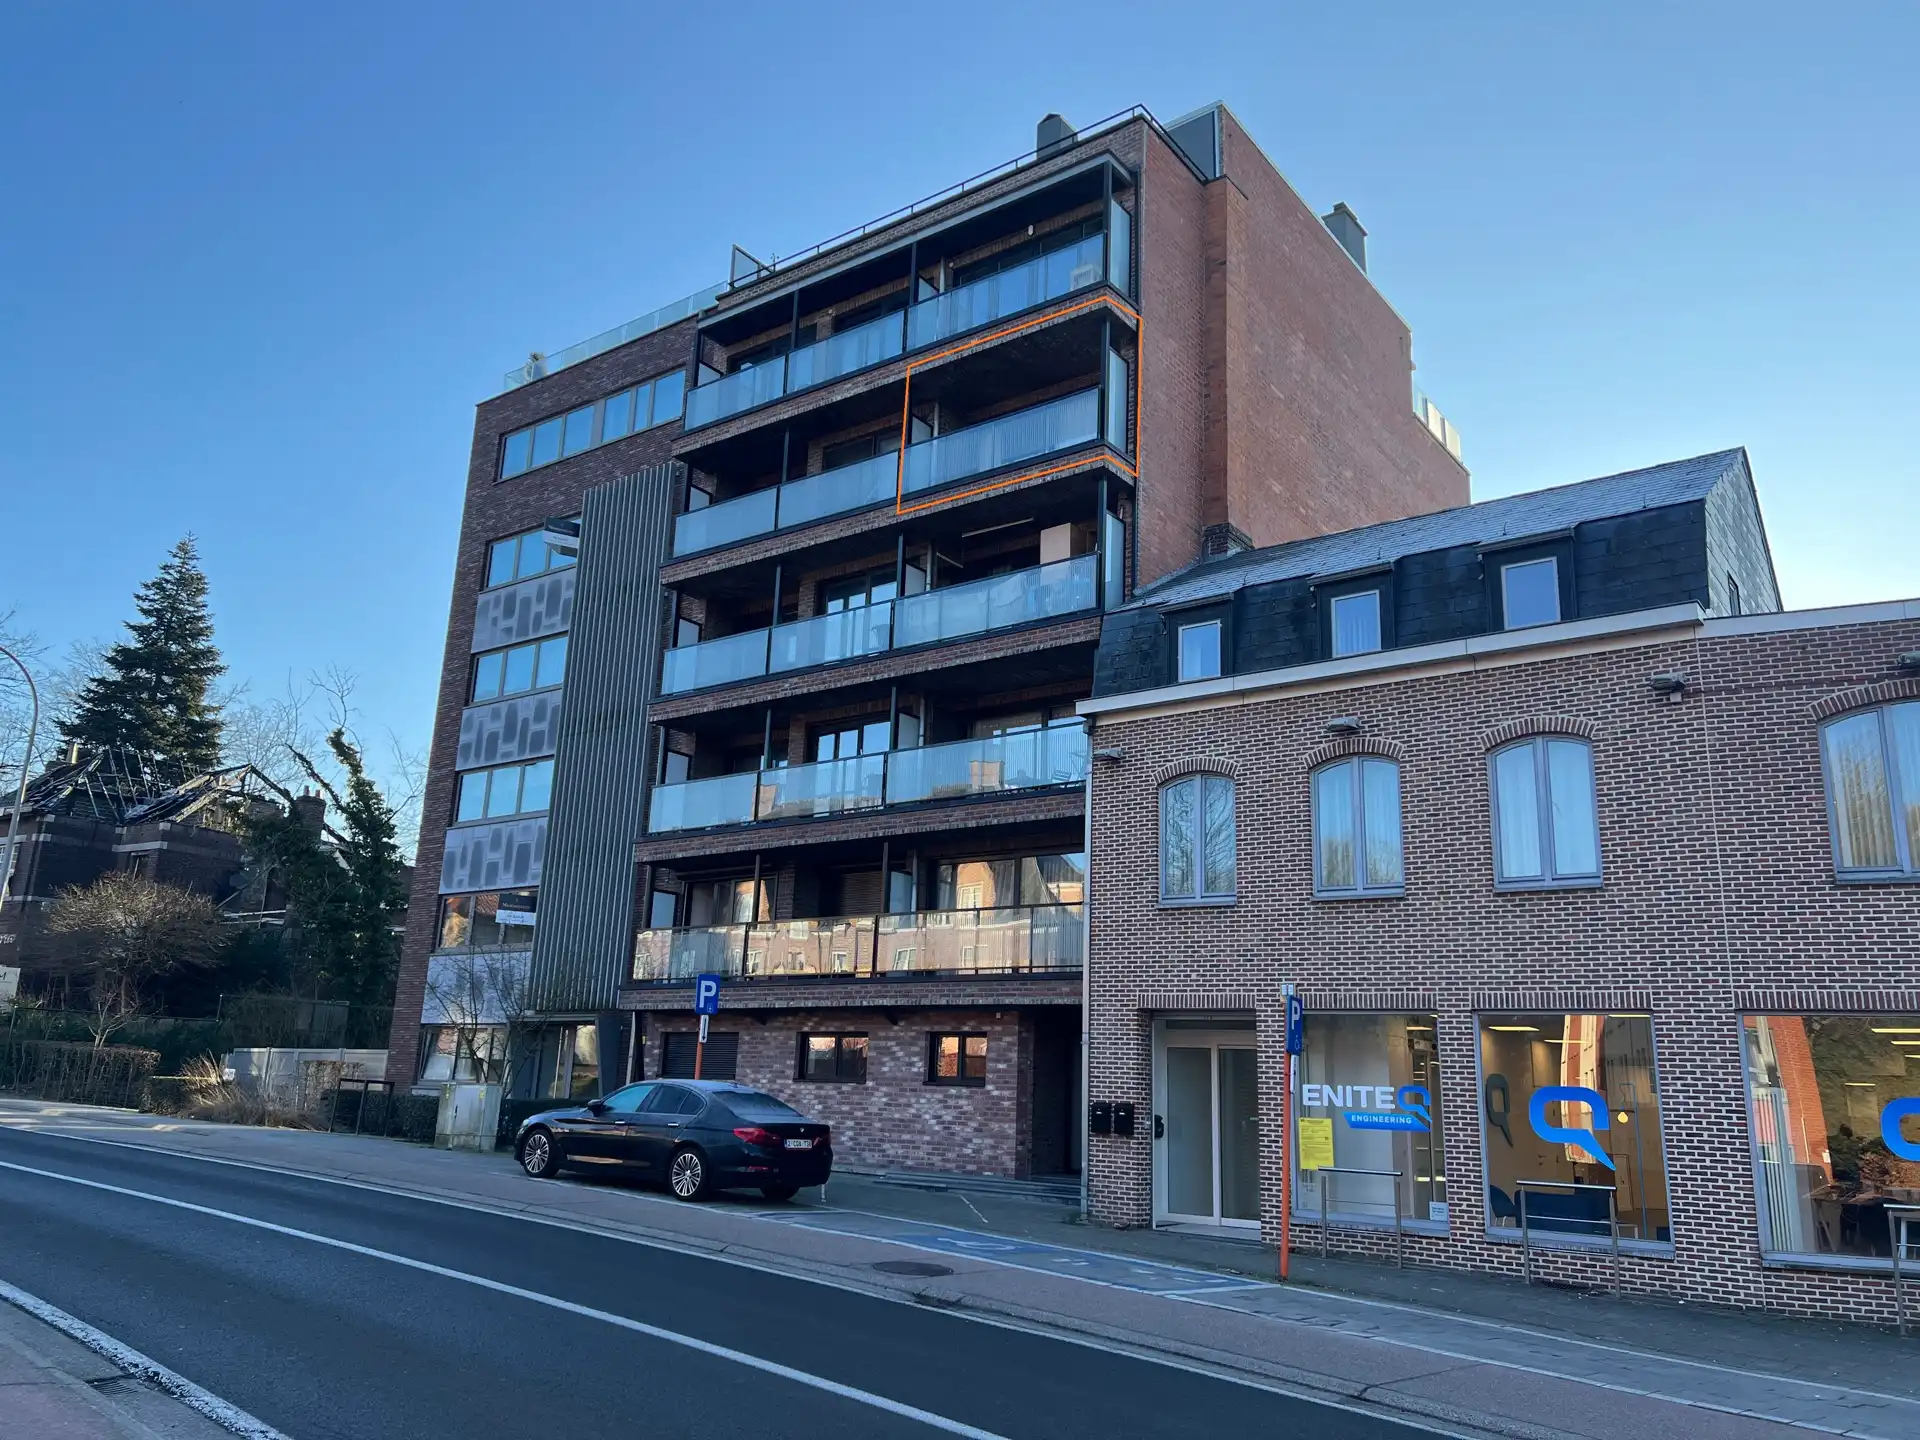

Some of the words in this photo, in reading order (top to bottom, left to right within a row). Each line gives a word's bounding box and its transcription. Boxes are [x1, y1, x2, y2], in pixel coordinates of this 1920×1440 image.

[699, 980, 716, 1008] P
[1291, 1000, 1300, 1030] P
[1351, 1114, 1413, 1125] ENGINEERING
